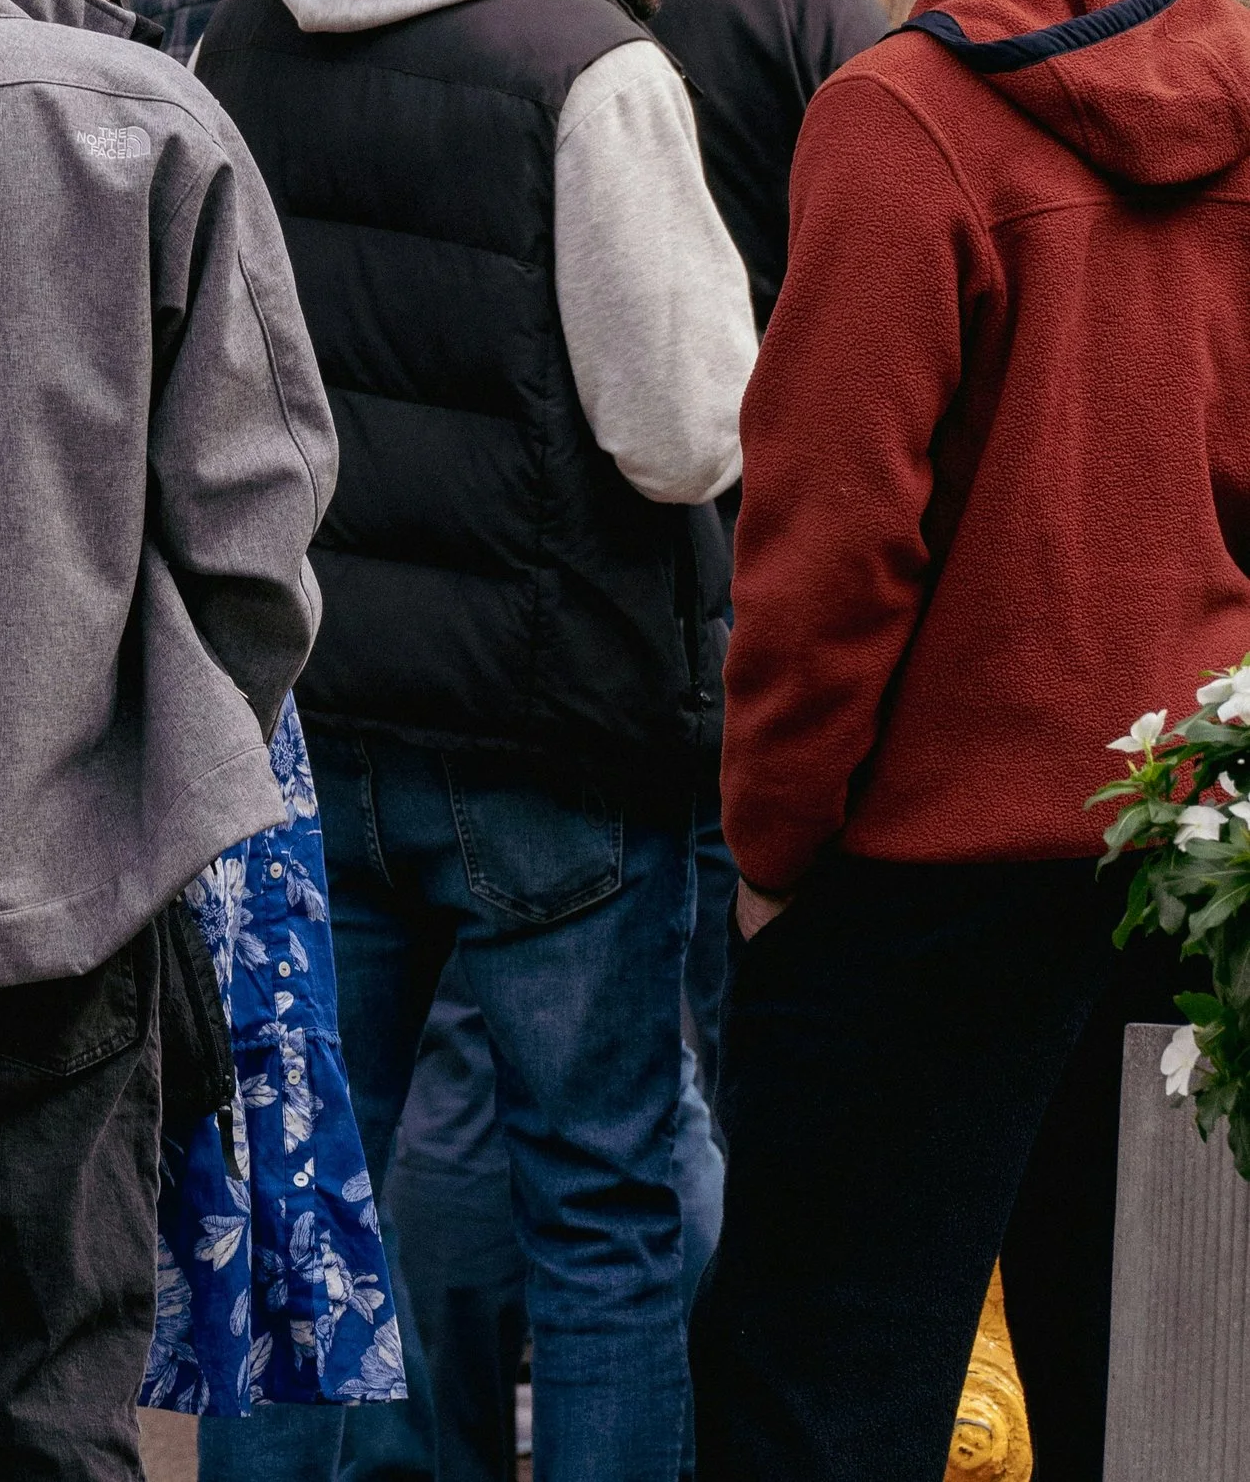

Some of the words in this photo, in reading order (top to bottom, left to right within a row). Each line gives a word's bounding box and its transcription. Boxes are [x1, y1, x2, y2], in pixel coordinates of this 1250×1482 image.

[98, 126, 127, 139] THE
[76, 130, 127, 150] NORTH
[90, 145, 126, 159] FACE
